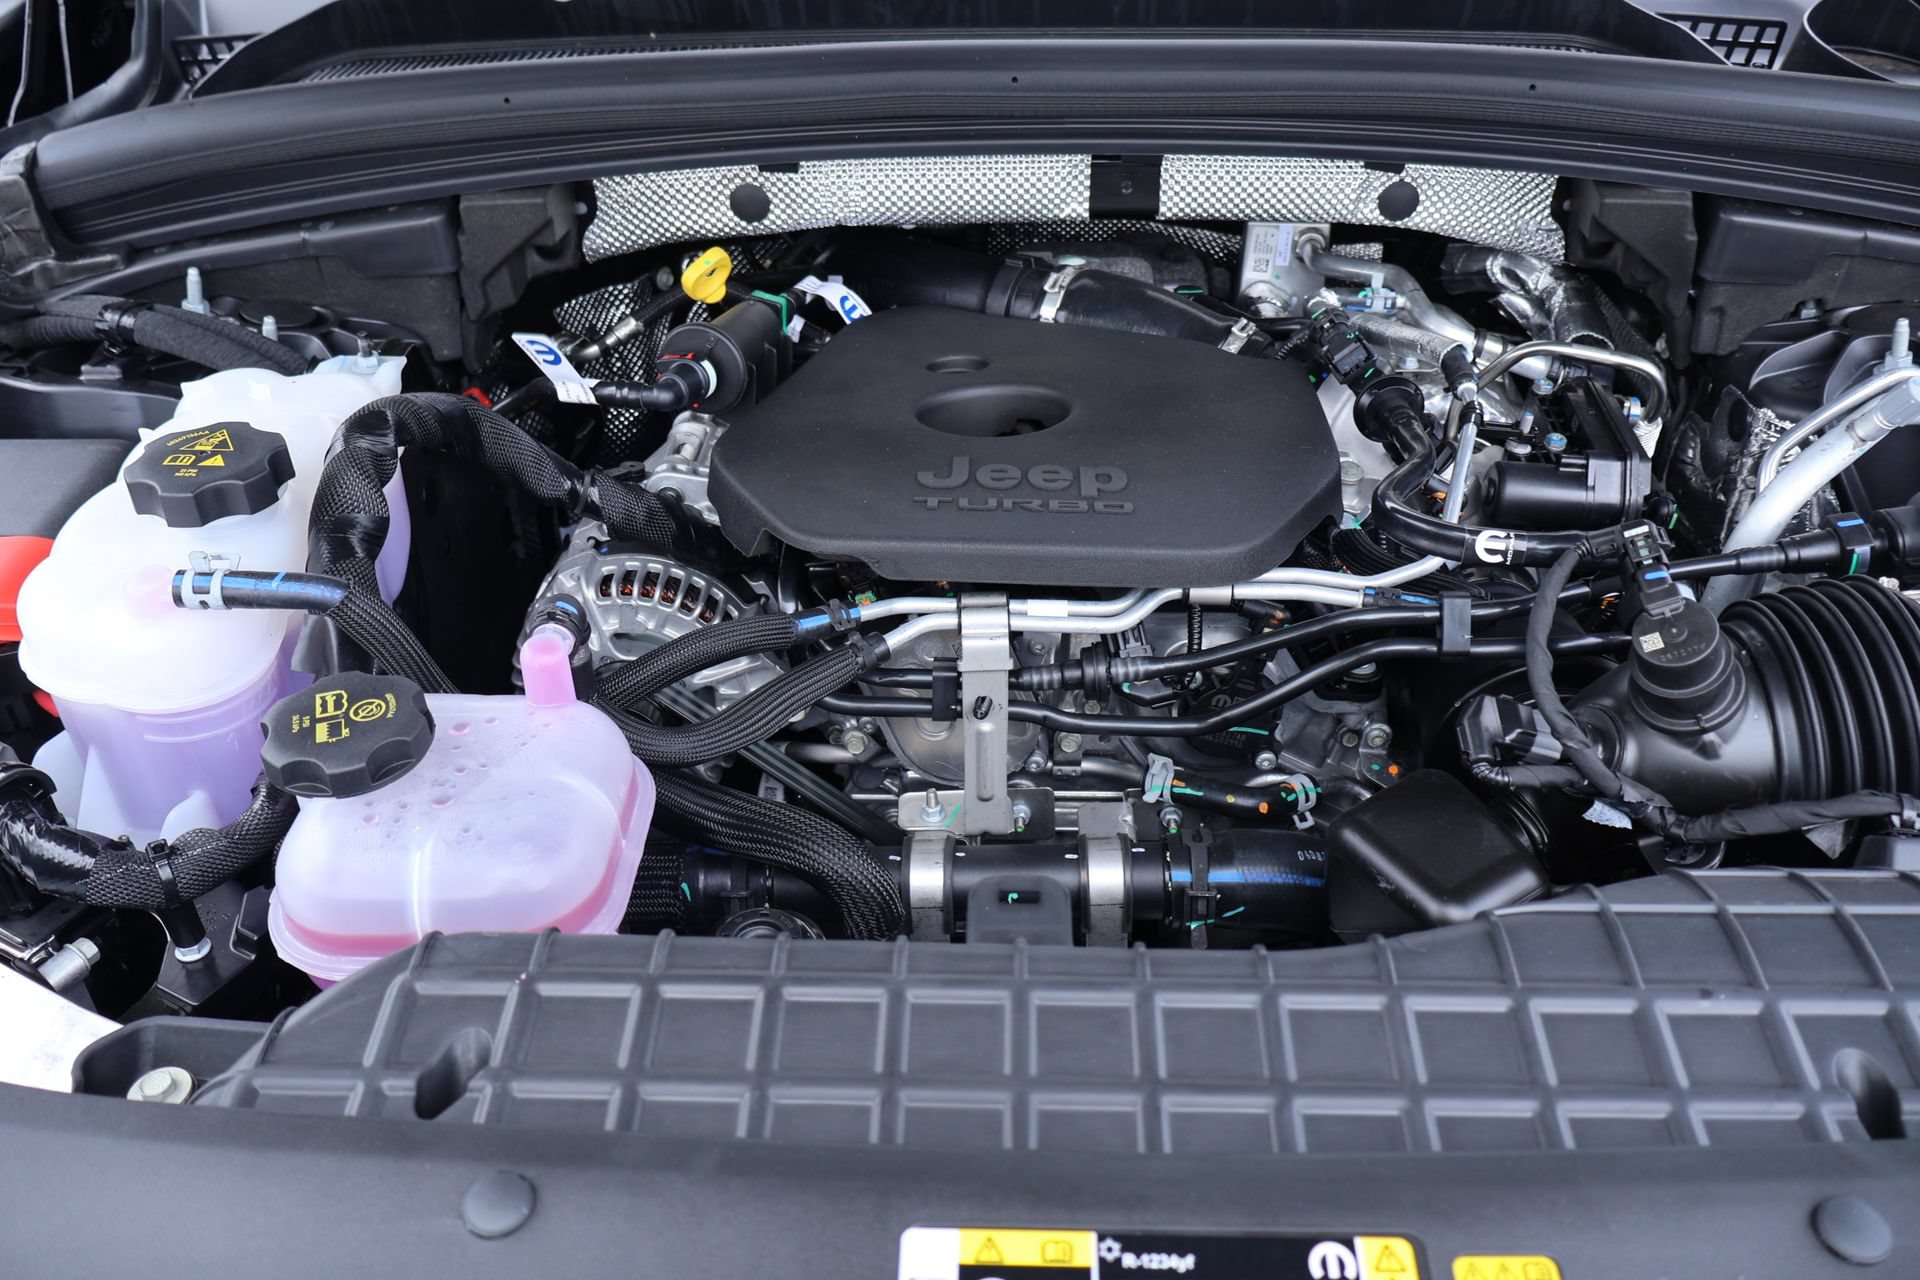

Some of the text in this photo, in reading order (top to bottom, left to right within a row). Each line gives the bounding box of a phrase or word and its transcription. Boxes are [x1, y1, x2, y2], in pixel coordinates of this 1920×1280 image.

[916, 456, 1128, 498] Jeep
[913, 496, 1135, 515] TURBO
[1121, 1252, 1196, 1274] R-1234yf
